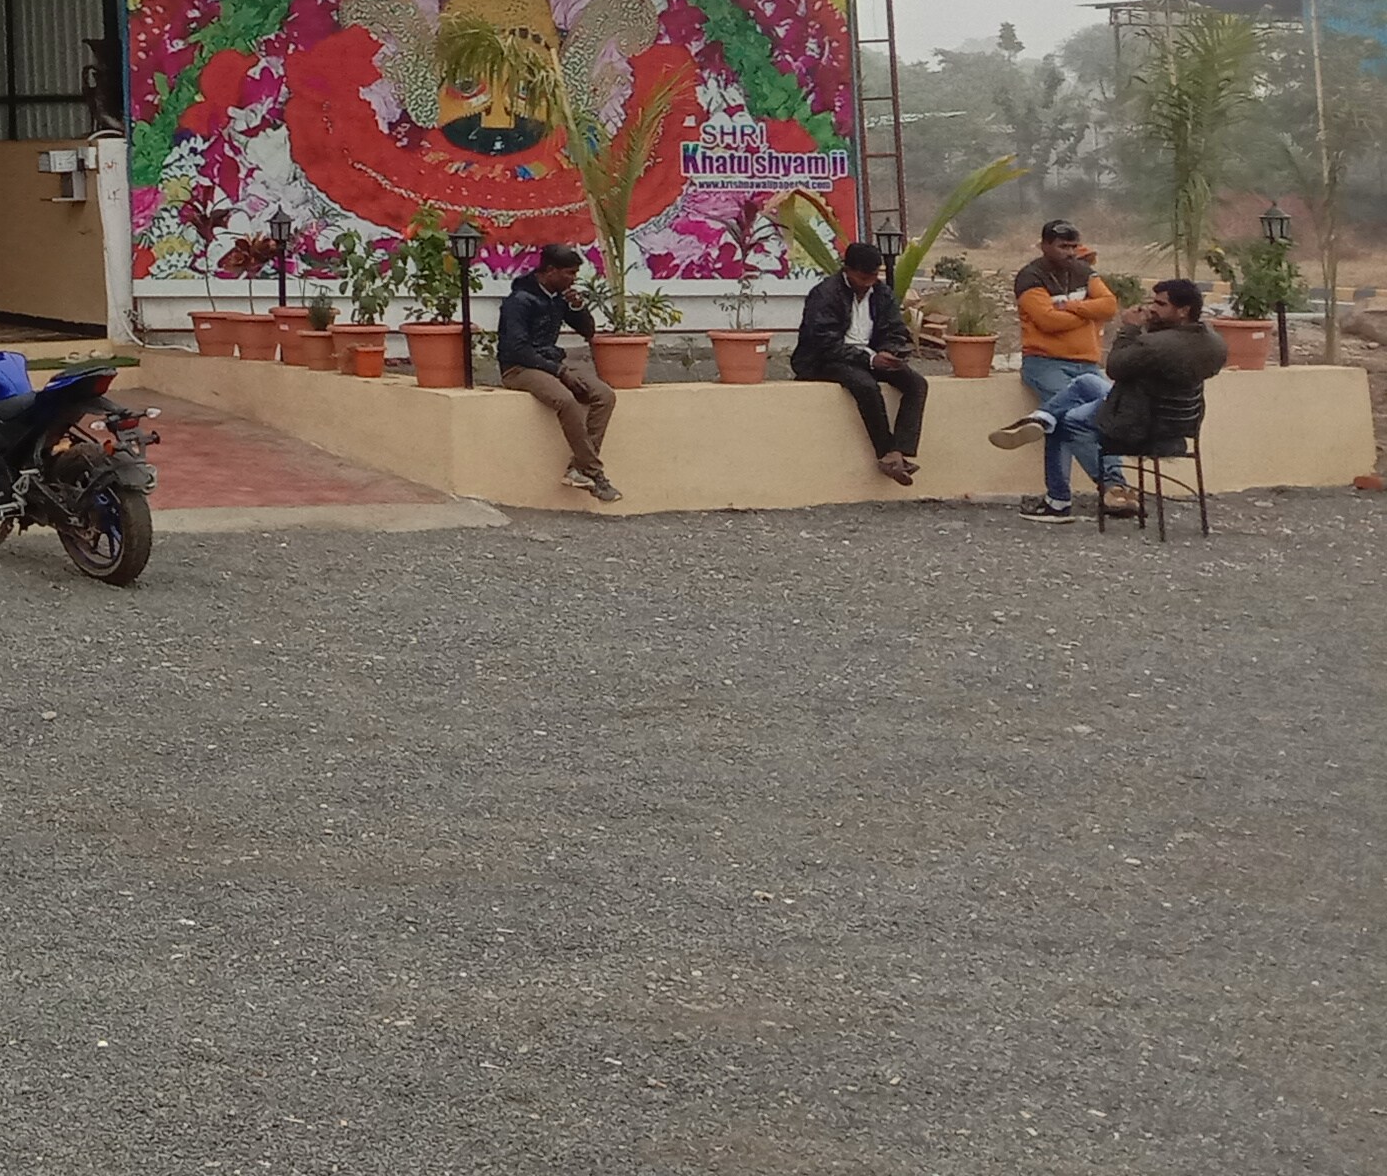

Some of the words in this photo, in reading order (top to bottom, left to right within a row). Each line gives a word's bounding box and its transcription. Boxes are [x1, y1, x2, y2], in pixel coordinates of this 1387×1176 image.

[701, 124, 766, 145] SHRI
[682, 144, 750, 175] Khatu
[754, 150, 827, 177] shyam
[830, 151, 847, 179] ji
